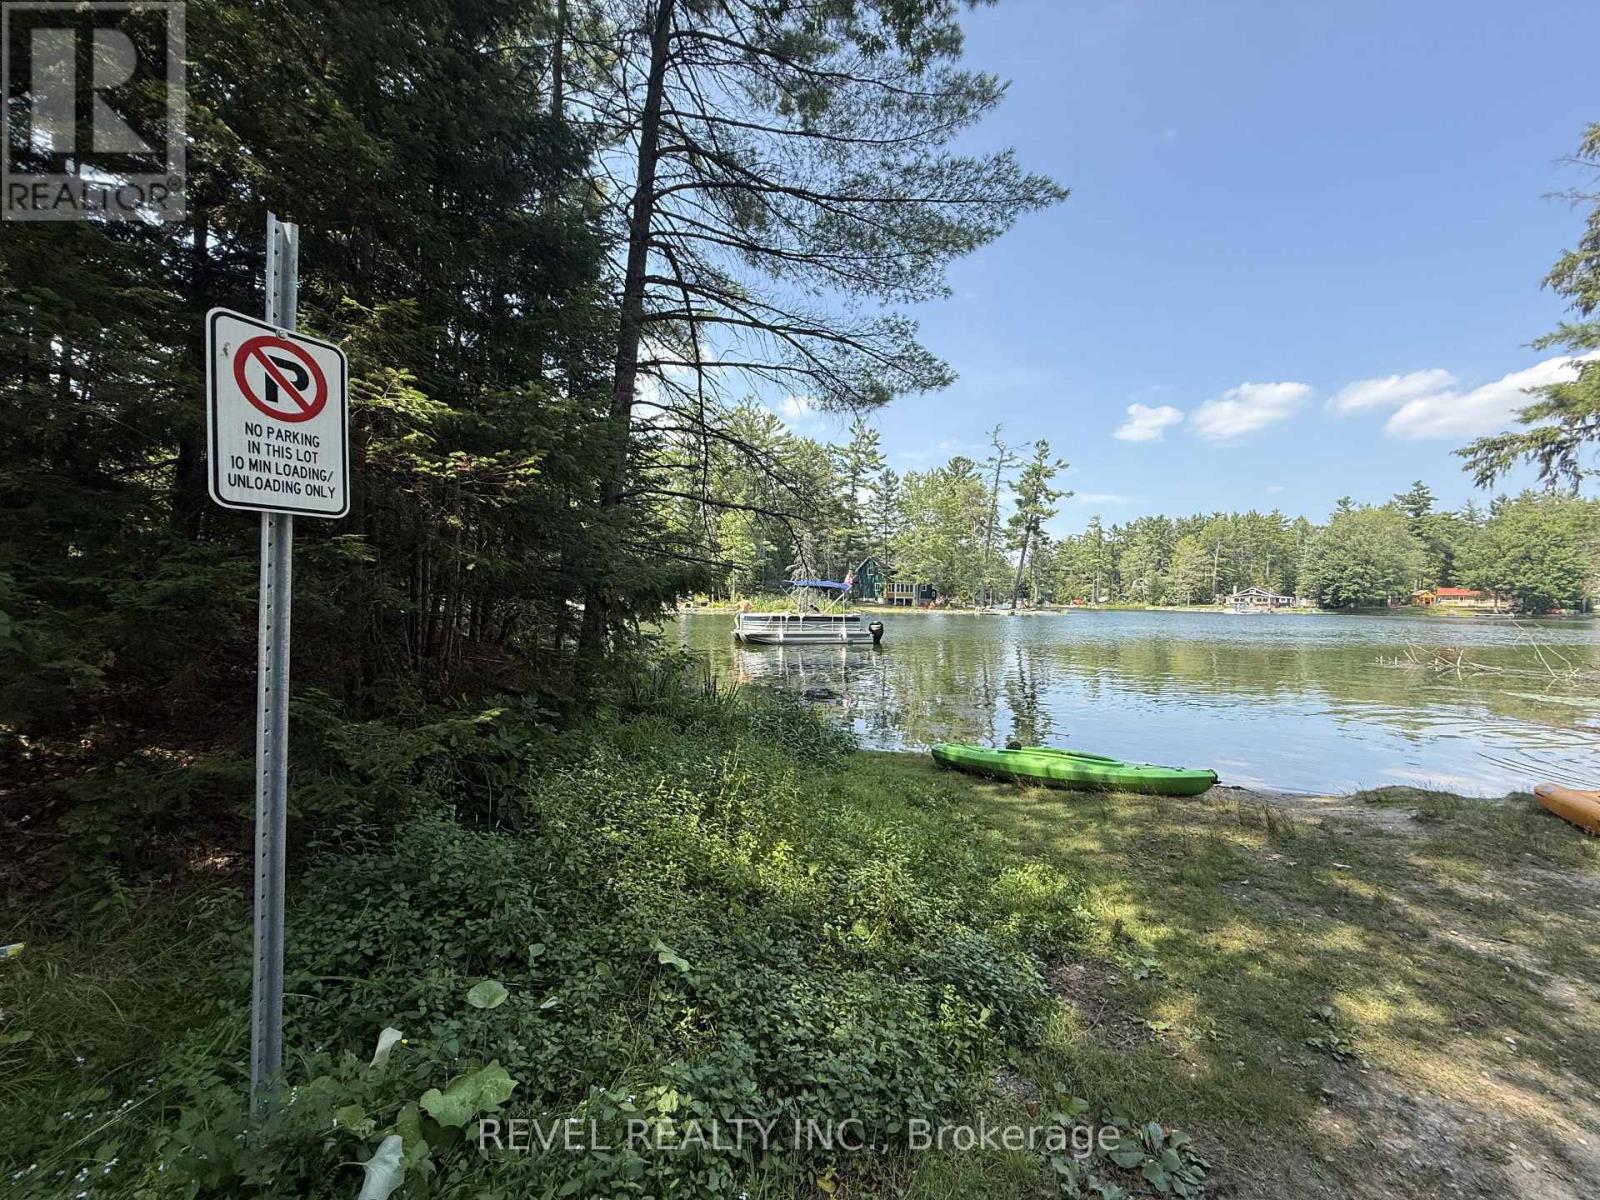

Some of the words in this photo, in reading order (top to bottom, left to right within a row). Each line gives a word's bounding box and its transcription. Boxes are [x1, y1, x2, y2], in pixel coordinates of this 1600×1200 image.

[265, 354, 310, 403] P
[245, 421, 262, 437] NO
[267, 426, 320, 448] PARKING
[248, 440, 261, 455] IN
[265, 443, 293, 460] THIS
[296, 449, 318, 464] LOT
[231, 455, 244, 470] 10
[249, 458, 272, 474] MIN
[275, 462, 334, 482] LOADING/
[228, 473, 301, 495] UNLOADING
[305, 484, 336, 499] ONLY
